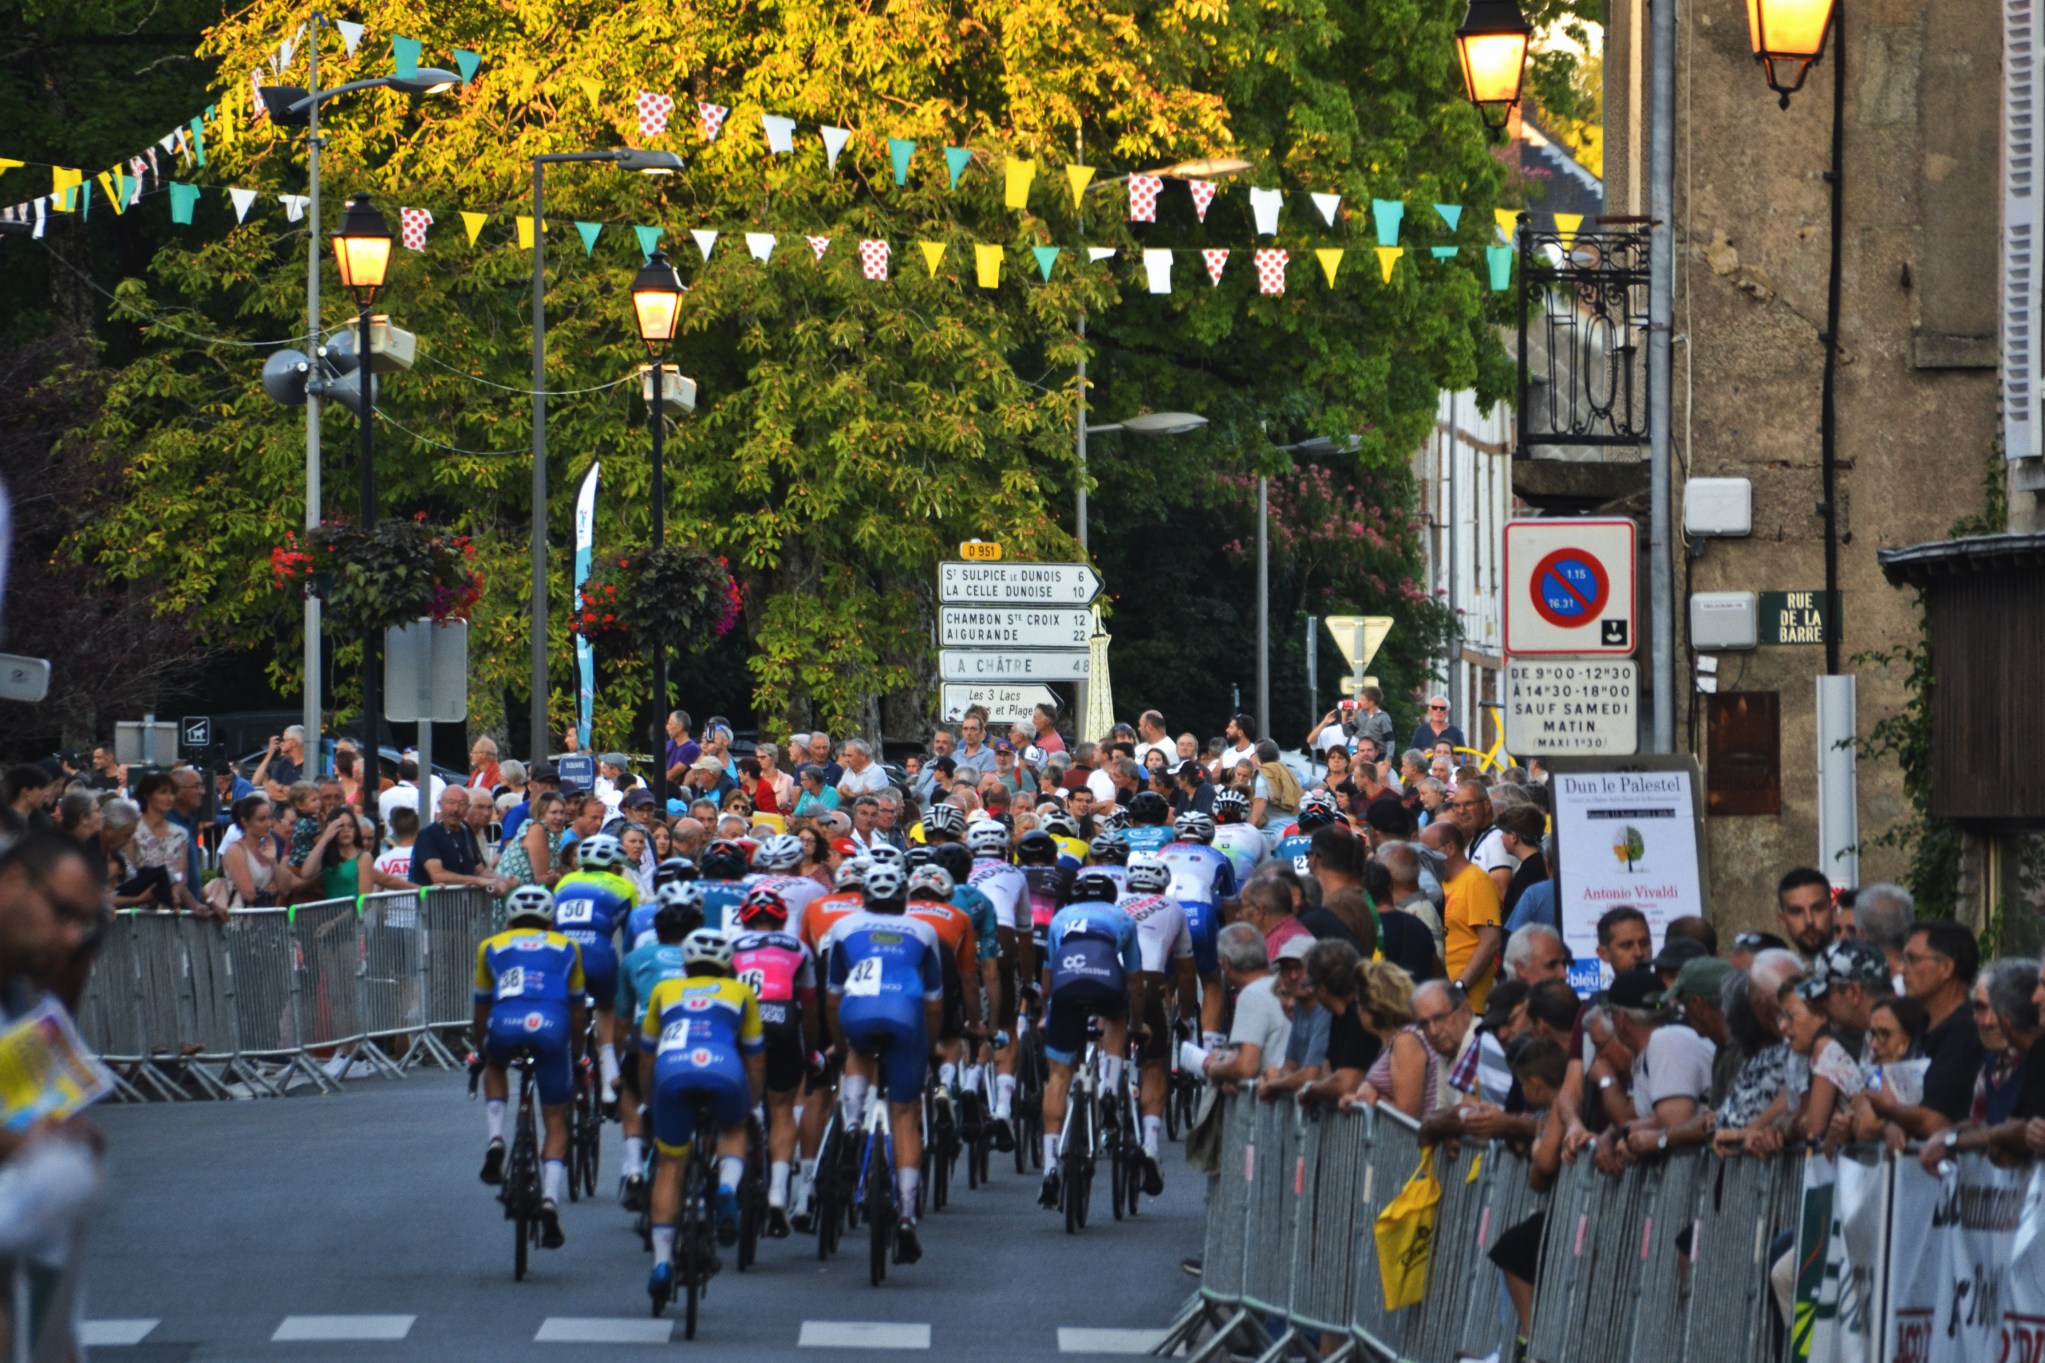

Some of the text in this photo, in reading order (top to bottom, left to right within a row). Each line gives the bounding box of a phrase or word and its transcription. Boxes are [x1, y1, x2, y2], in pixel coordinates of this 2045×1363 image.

[968, 545, 995, 557] D 951
[962, 569, 1007, 582] SULPICE
[1021, 570, 1062, 583] DUNOIS
[1077, 571, 1085, 583] 6
[1567, 568, 1587, 580] 1.15
[946, 584, 1086, 599] LA CELLE DUNOISE 10
[1787, 592, 1813, 609] RUE
[946, 612, 1001, 626] CHAMBON
[1027, 614, 1061, 627] CROIX
[1073, 614, 1086, 626] 12
[1780, 609, 1822, 626] DE LA
[946, 628, 1086, 642] AIGURANDE 22
[1780, 626, 1822, 643] BARRE
[976, 656, 1033, 673] CHÂTRE
[1511, 668, 1529, 680] DE
[969, 688, 1021, 702] Les 3 Lacs
[1513, 682, 1521, 698] À
[995, 705, 1005, 717] et
[1515, 702, 1629, 715] SAUF SAMEDI
[1543, 720, 1596, 733] MATIN
[1564, 775, 1681, 794] Dun le Palestel
[1583, 884, 1679, 901] Antonio Vivaldi
[564, 900, 586, 918] 50
